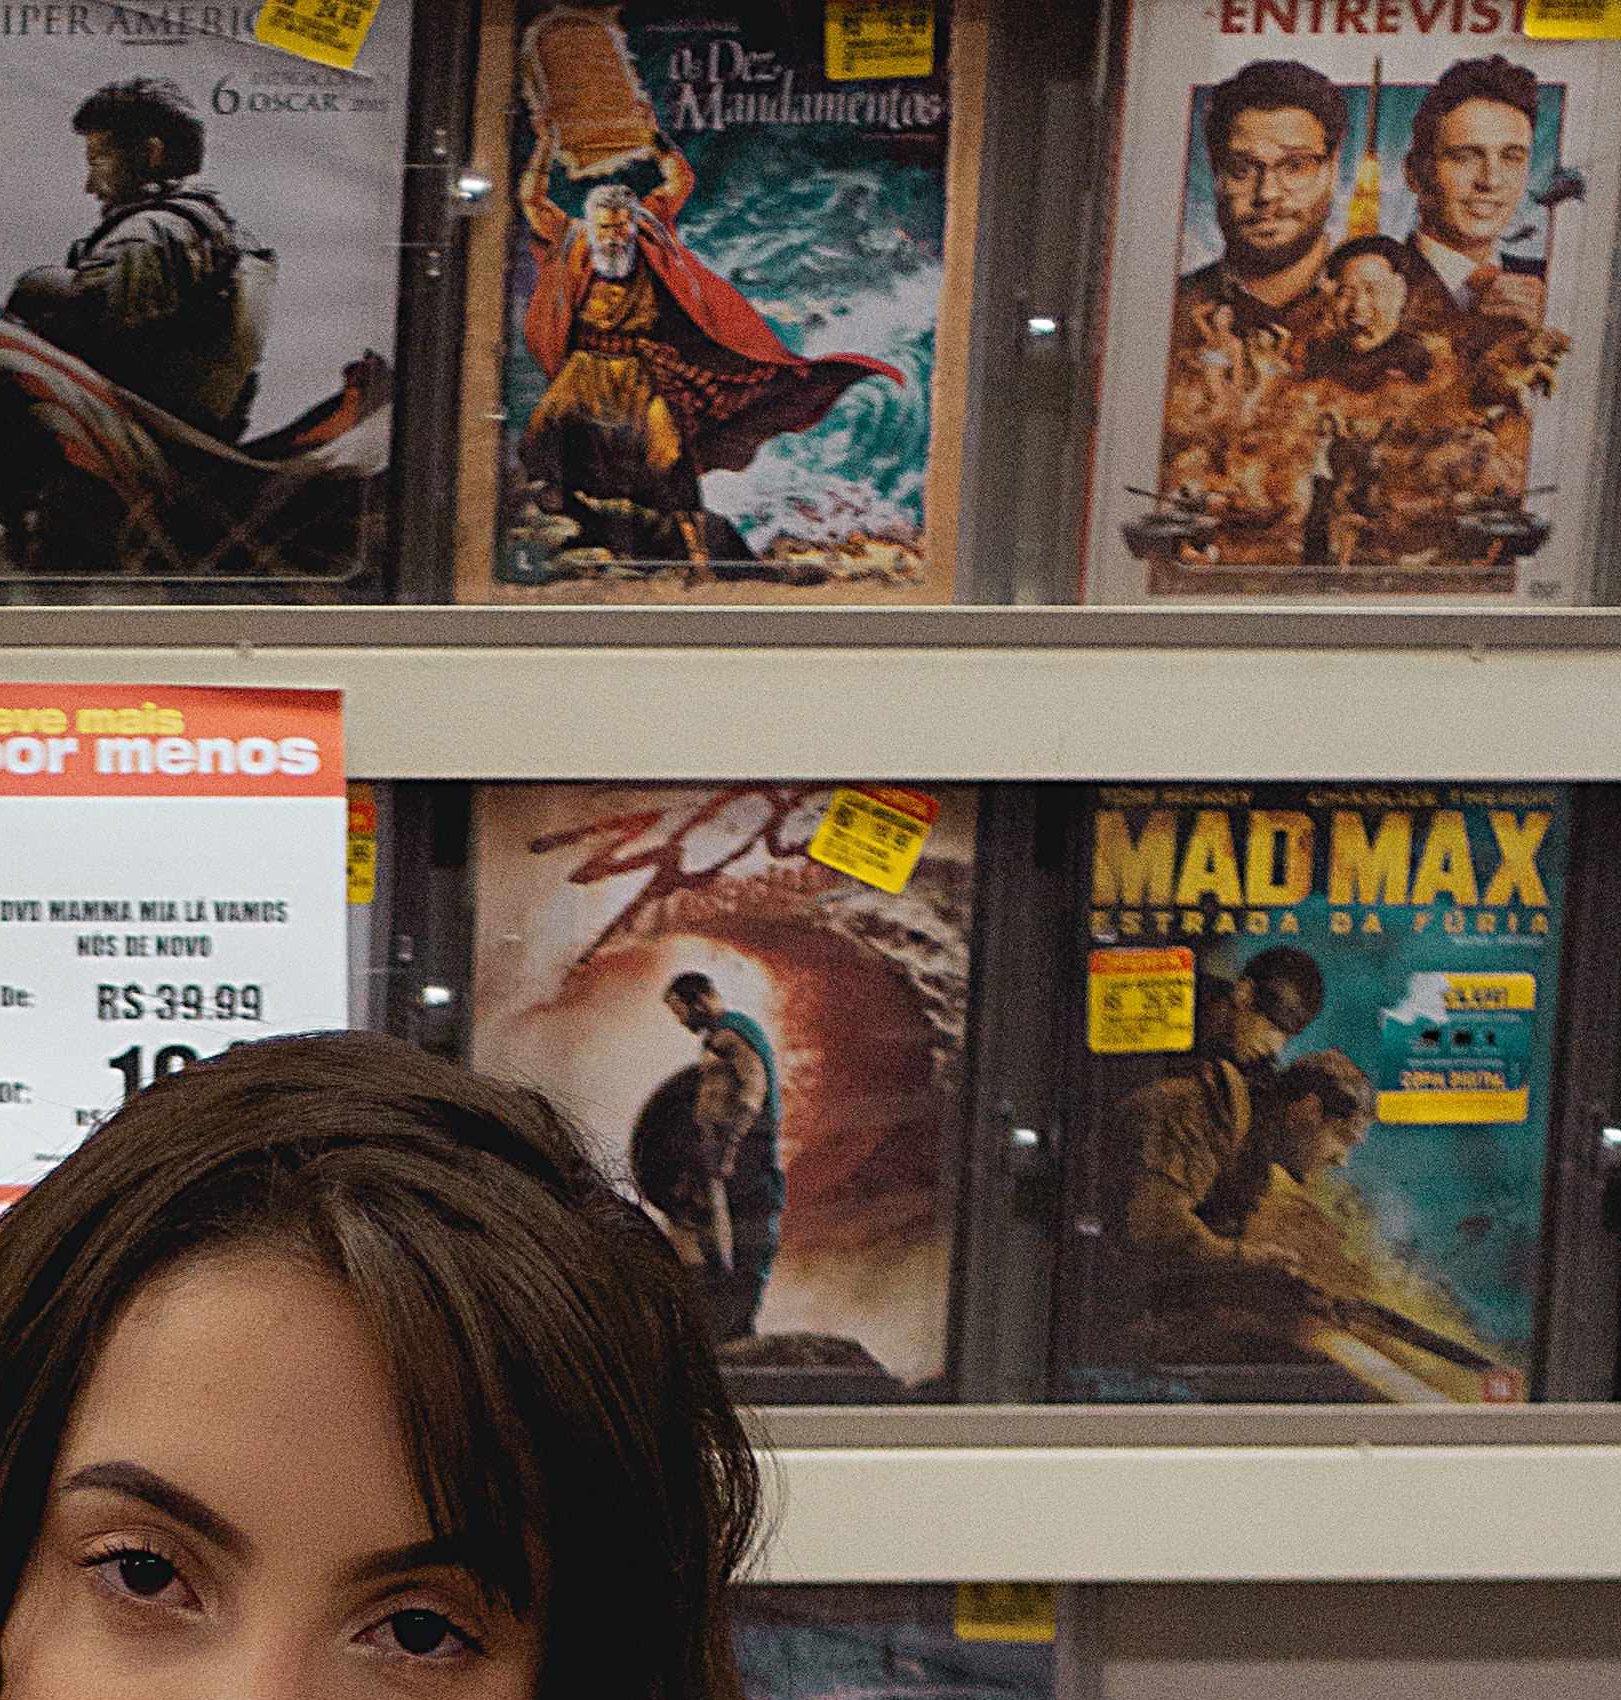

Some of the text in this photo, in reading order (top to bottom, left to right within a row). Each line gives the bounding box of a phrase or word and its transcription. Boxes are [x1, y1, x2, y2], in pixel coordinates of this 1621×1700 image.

[211, 73, 241, 116] 6
[76, 701, 185, 735] mais
[95, 736, 321, 776] menos
[1091, 809, 1554, 908] MAD MAX
[0, 899, 42, 923] DVD
[49, 899, 132, 923] MAMMA
[140, 899, 177, 923] MIA
[214, 899, 288, 923] VAMOS
[1090, 910, 1301, 937] ESTRADA
[1330, 910, 1384, 937] DA
[125, 935, 152, 957] DE
[156, 935, 213, 957] NOVO
[97, 982, 143, 1021] R$
